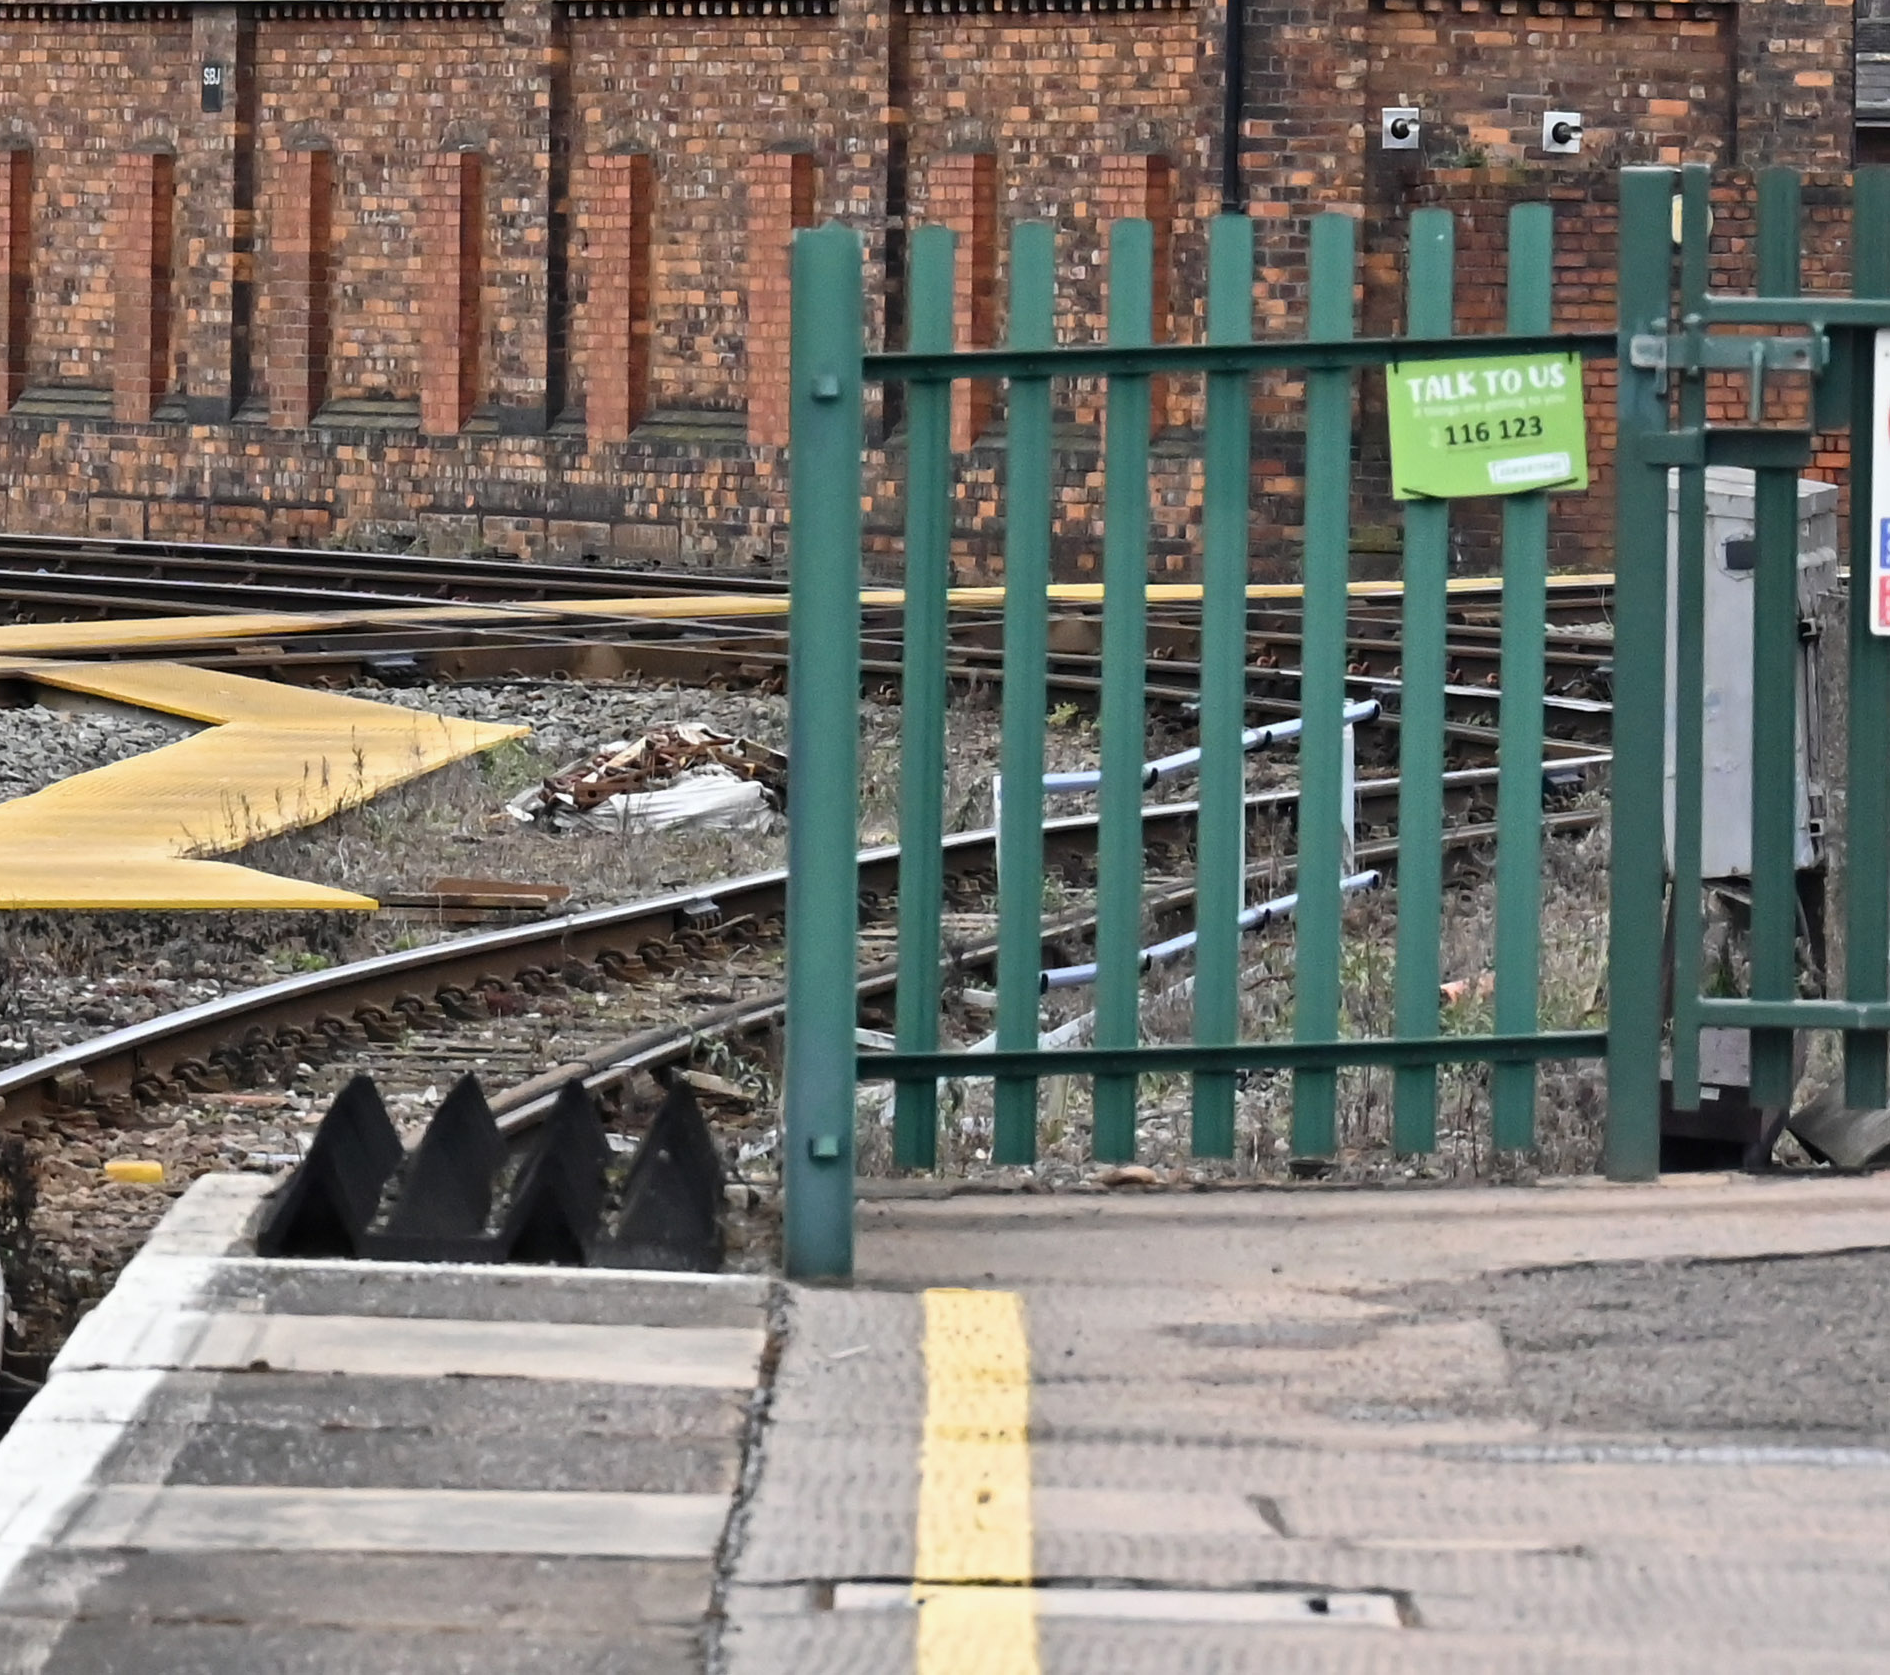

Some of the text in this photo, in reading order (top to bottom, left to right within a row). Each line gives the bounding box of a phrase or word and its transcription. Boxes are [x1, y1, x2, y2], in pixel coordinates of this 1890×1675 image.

[203, 67, 221, 85] SBJ
[1405, 362, 1567, 403] TALK TO US
[1444, 416, 1543, 445] 116 123
